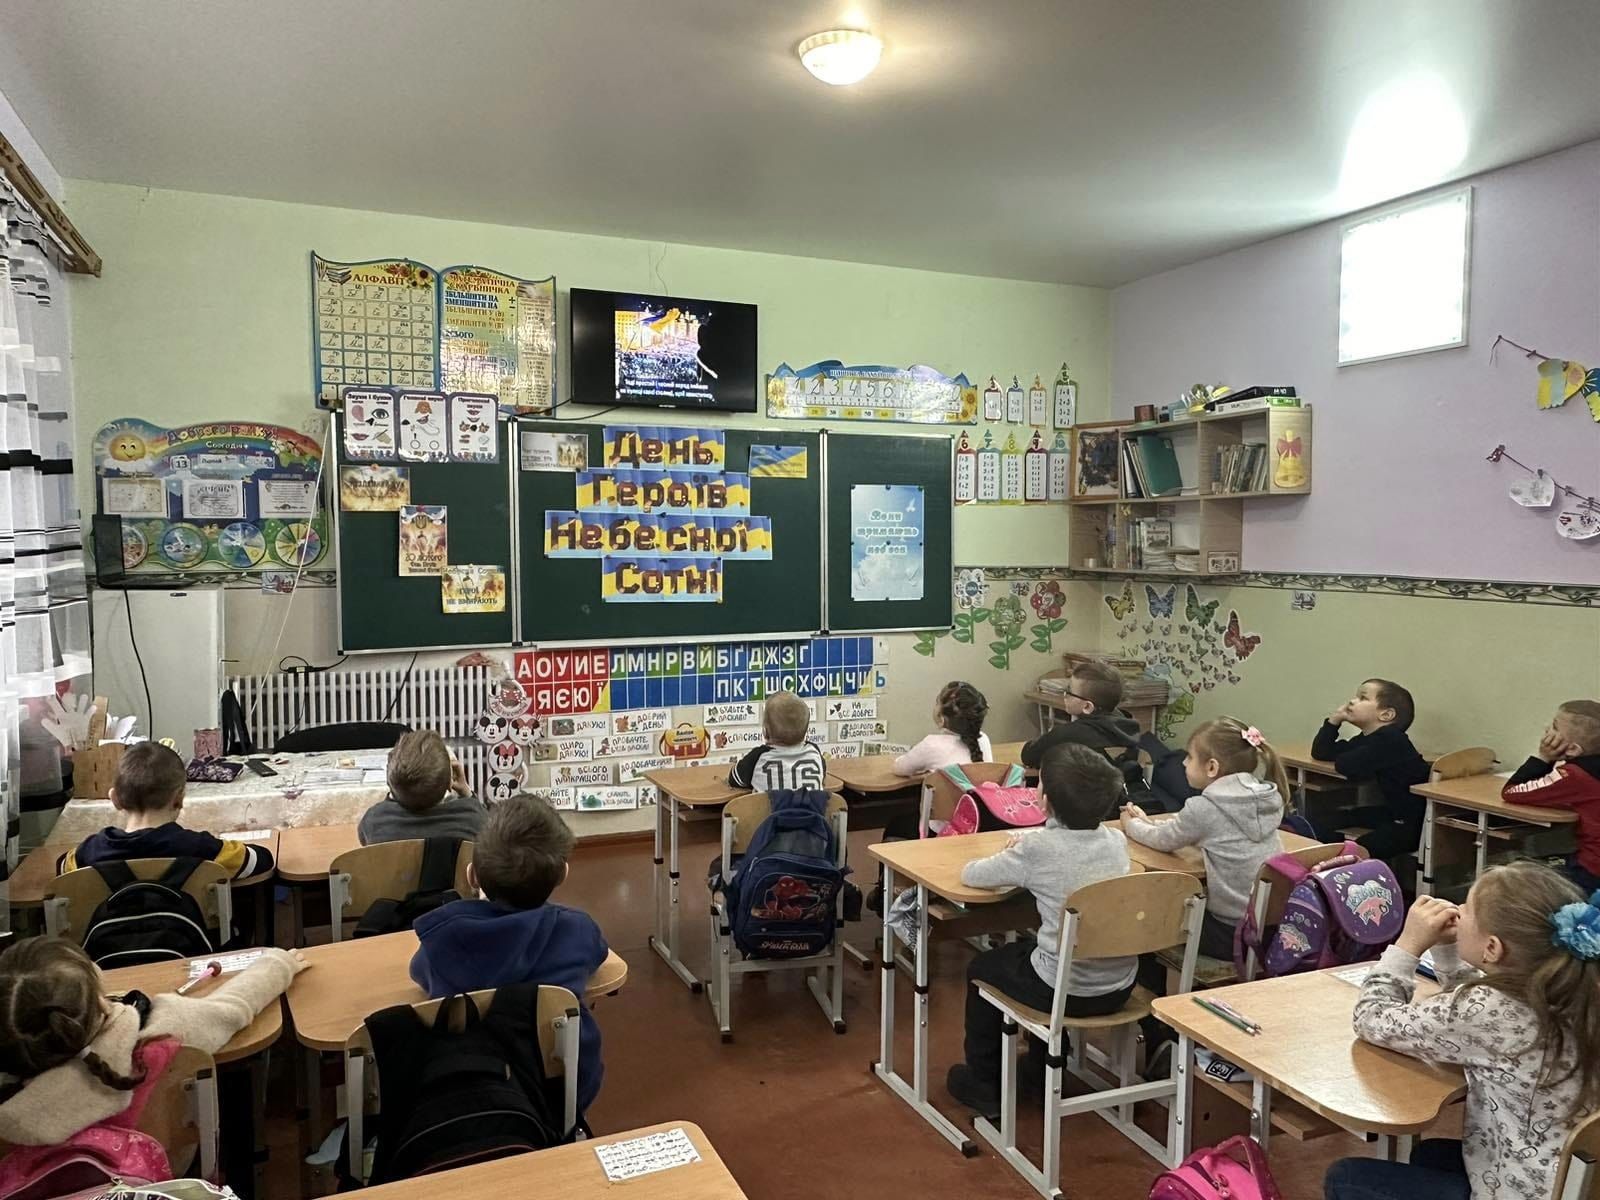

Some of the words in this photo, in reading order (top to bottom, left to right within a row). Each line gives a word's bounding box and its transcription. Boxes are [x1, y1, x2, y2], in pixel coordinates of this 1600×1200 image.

[353, 274, 405, 285] АЛФАВІТ
[811, 379, 821, 395] 2
[830, 379, 840, 396] 3
[850, 379, 859, 396] 4
[866, 380, 876, 397] 5
[883, 381, 894, 398] 6
[206, 441, 243, 450] Сьогодні
[962, 439, 968, 449] 6
[985, 439, 992, 448] 7
[1009, 439, 1015, 449] 8
[1033, 439, 1039, 449] 9
[609, 431, 714, 469] День
[175, 460, 187, 468] 13
[592, 474, 728, 512] Героїв
[870, 510, 902, 521] Вони
[551, 517, 748, 552] Небесної
[615, 561, 718, 594] Сотні
[638, 712, 666, 724] ДОБРИЙ
[852, 709, 873, 717] ДОБРЕ!
[577, 721, 606, 731] ДЯКУЮ!
[643, 721, 664, 731] ДЕНЬ!
[560, 741, 584, 750] ЩИРО
[831, 746, 856, 755] ПРОШУ
[560, 750, 588, 760] ДЯКУЮ!
[578, 766, 607, 774] ВСЬОГО
[762, 760, 823, 791] 16
